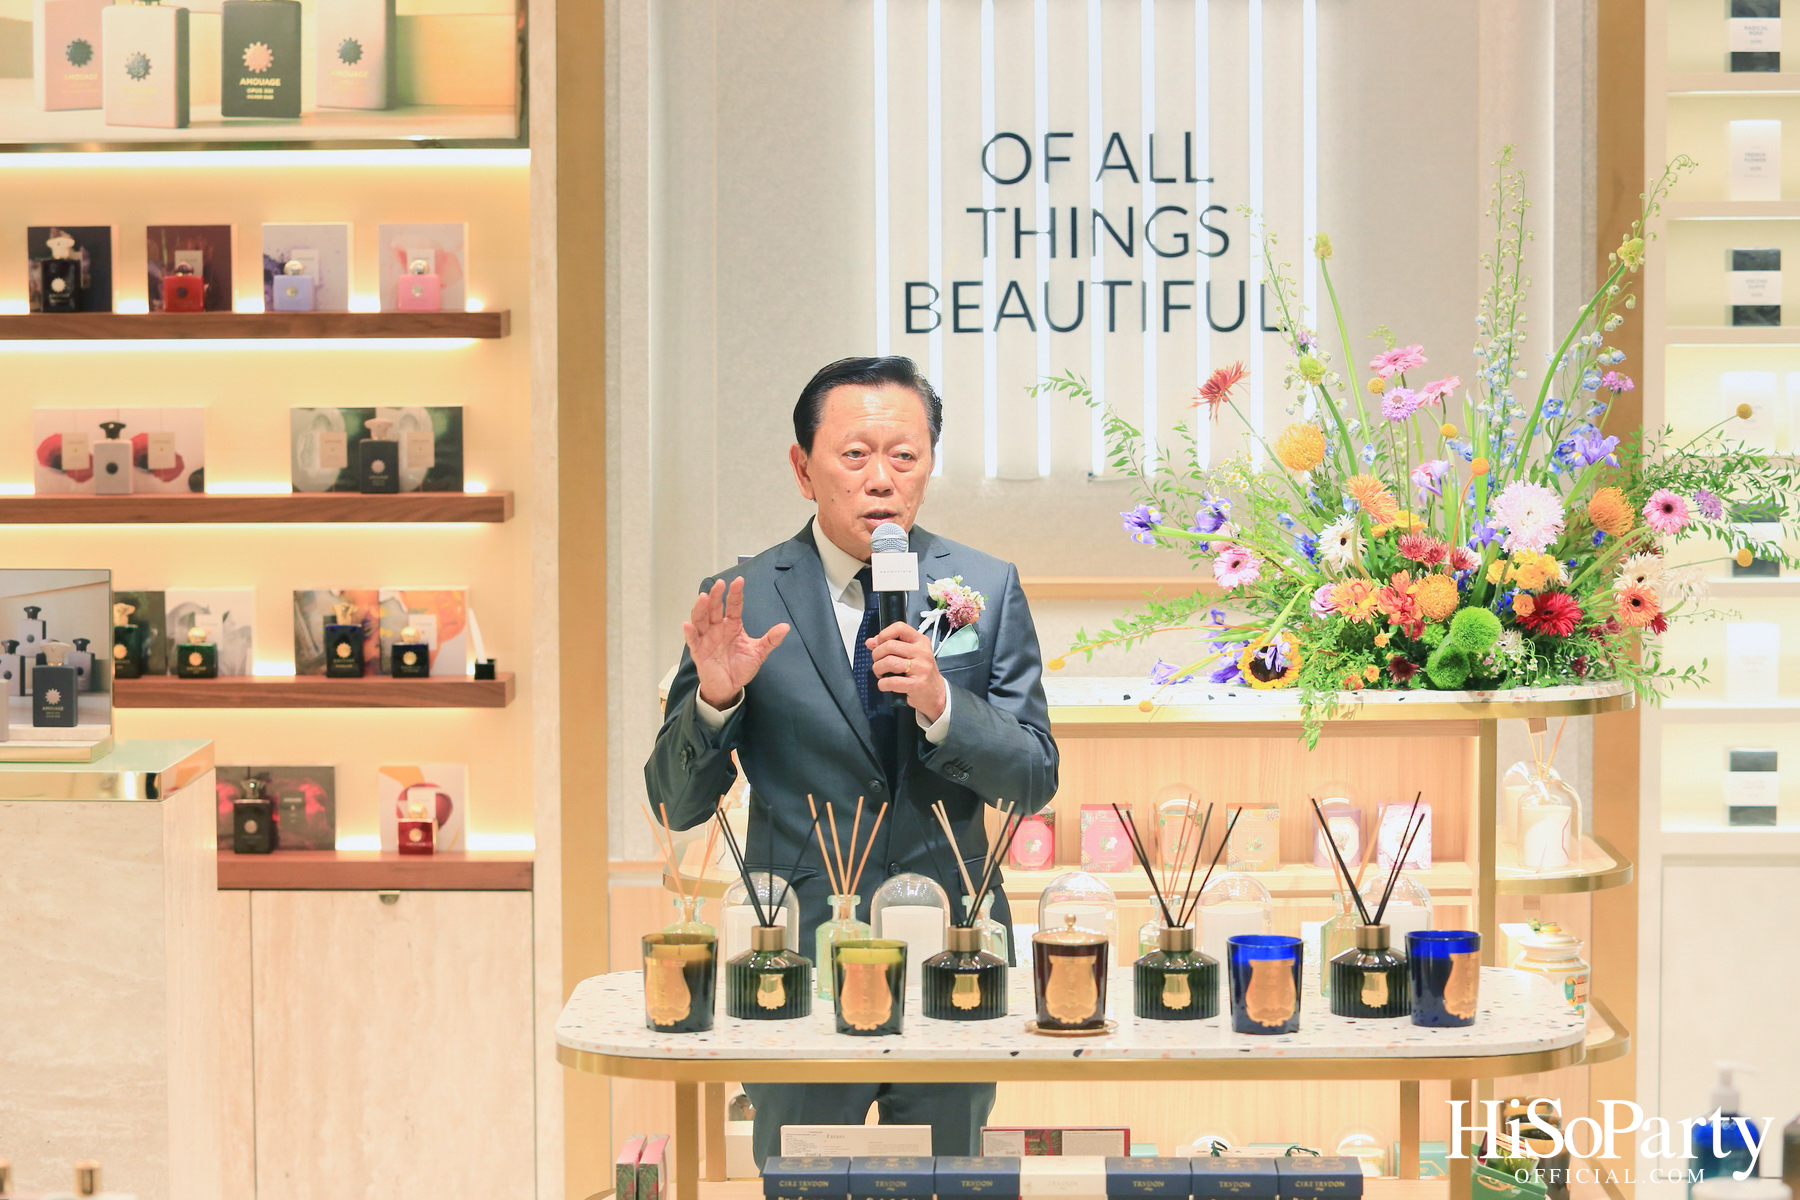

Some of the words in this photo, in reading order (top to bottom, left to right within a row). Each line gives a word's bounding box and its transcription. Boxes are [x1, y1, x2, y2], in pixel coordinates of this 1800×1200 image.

[239, 77, 281, 87] AMOUAGE
[981, 131, 1074, 185] OF
[1095, 131, 1215, 185] ALL
[966, 204, 1230, 259] THINGS
[904, 279, 1288, 334] BEAUTIFUL
